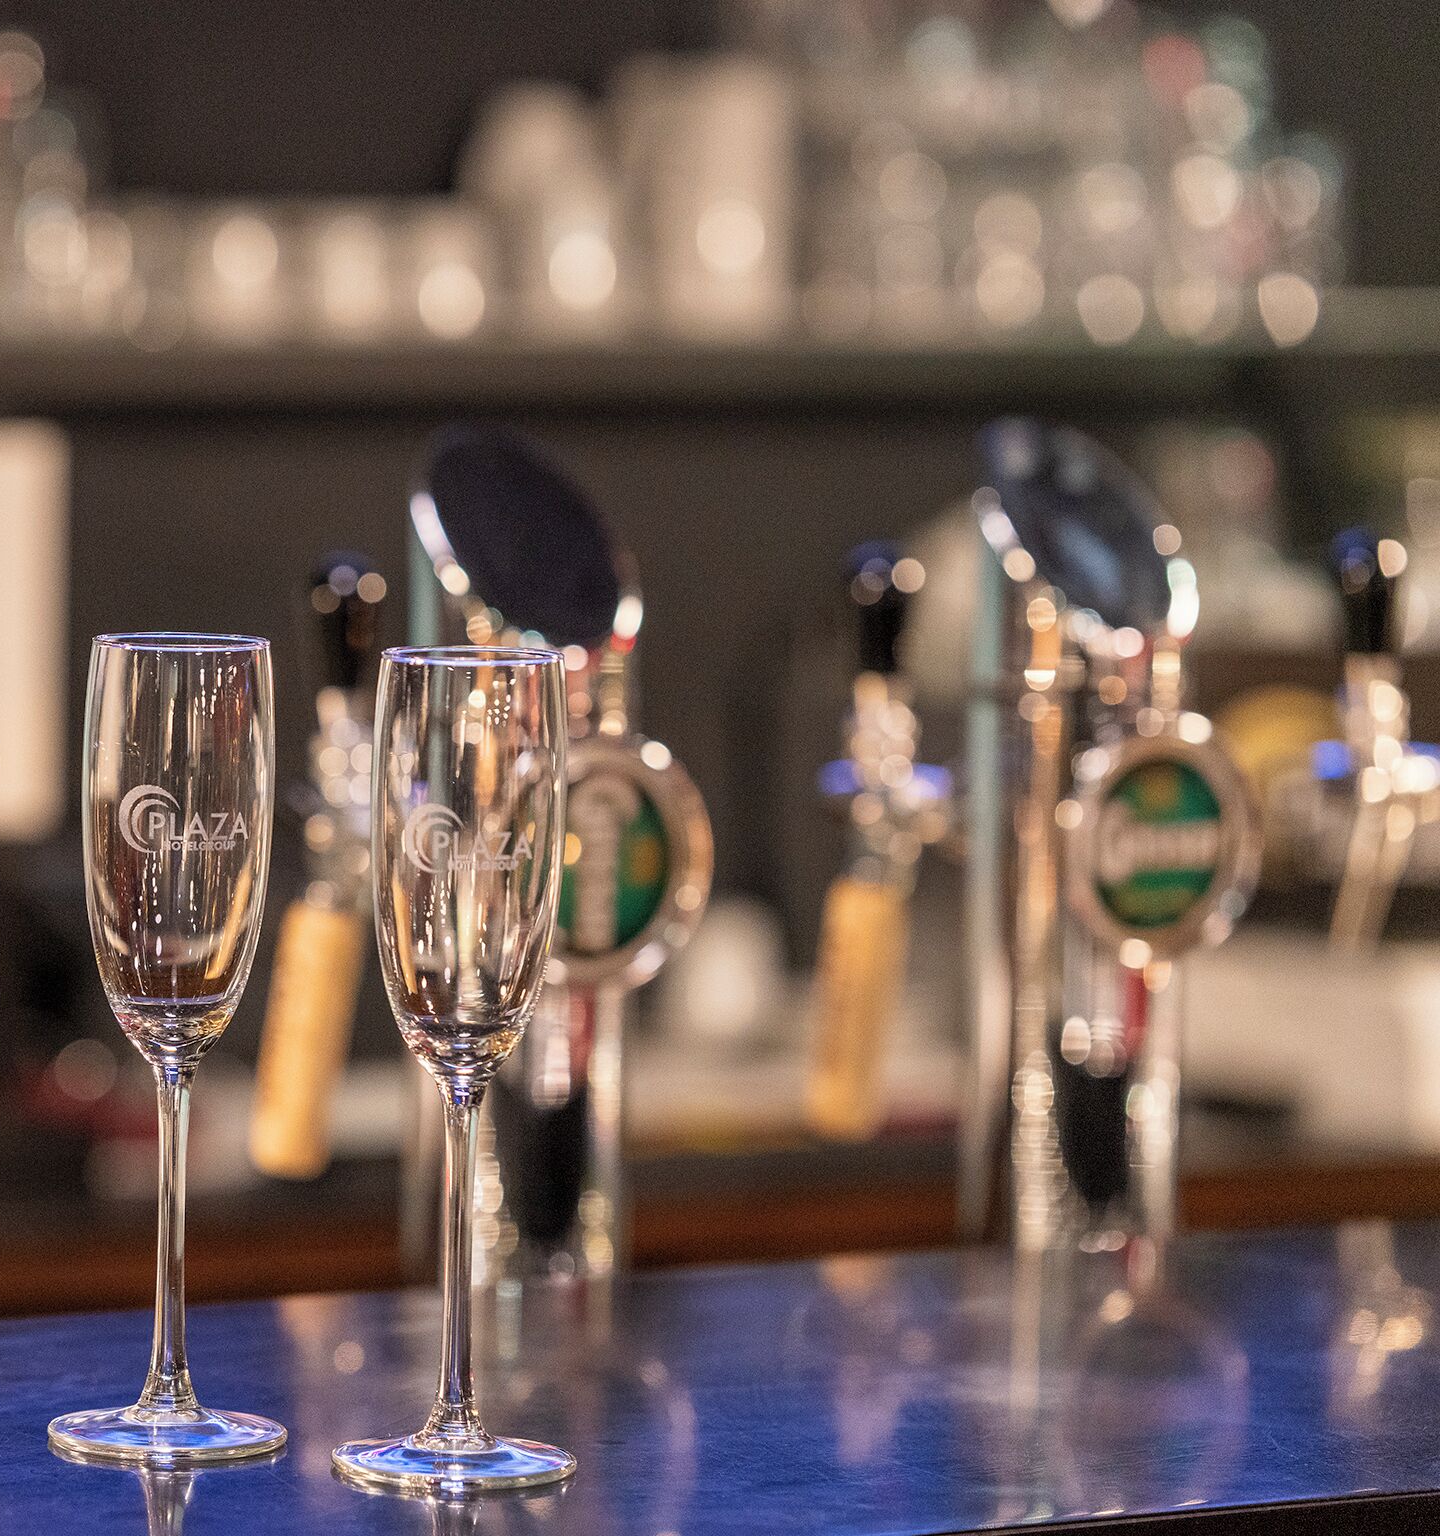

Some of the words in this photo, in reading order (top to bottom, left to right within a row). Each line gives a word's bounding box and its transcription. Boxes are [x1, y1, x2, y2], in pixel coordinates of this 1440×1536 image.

[149, 811, 249, 840] PLAZA
[164, 840, 236, 851] HOTELGROUP
[432, 831, 533, 860] PLAZA
